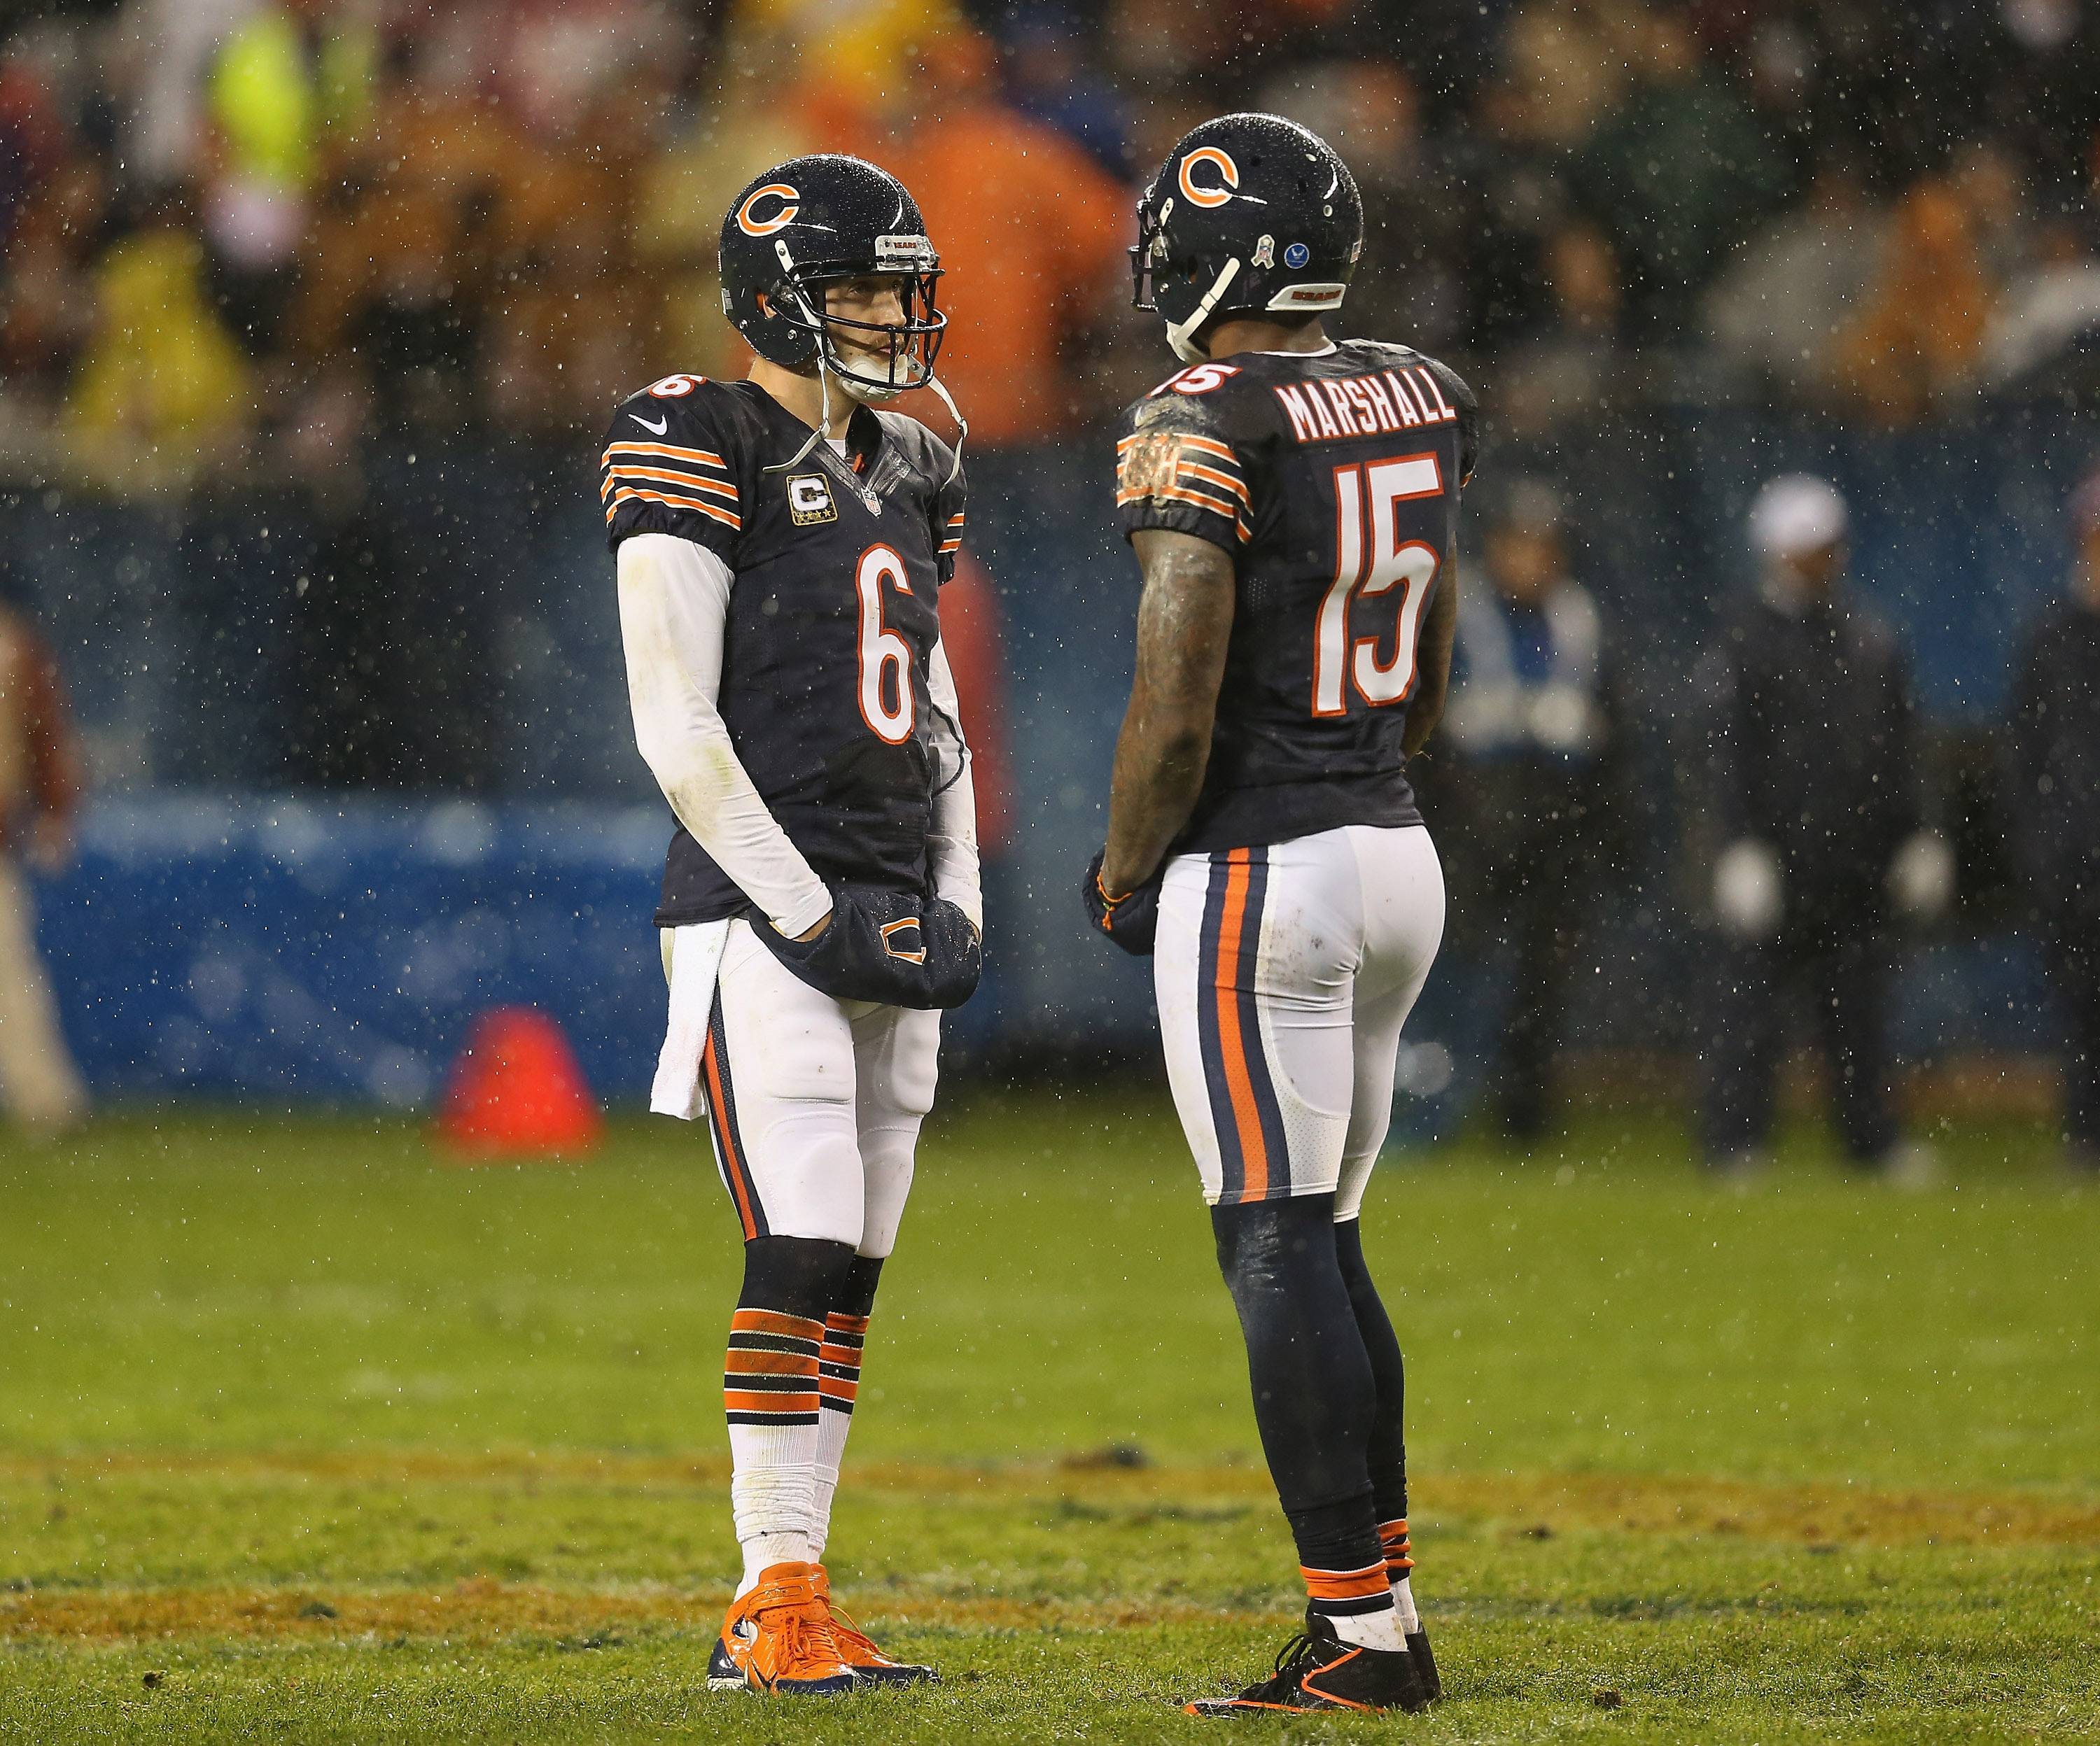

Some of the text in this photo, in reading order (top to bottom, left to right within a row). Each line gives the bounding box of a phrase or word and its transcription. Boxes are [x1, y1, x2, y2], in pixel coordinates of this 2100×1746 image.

[649, 374, 707, 399] 6
[1144, 362, 1243, 400] 15
[1274, 366, 1457, 442] MARSHALL
[790, 477, 829, 512] C
[1311, 451, 1444, 718] 15
[856, 542, 915, 747] 6
